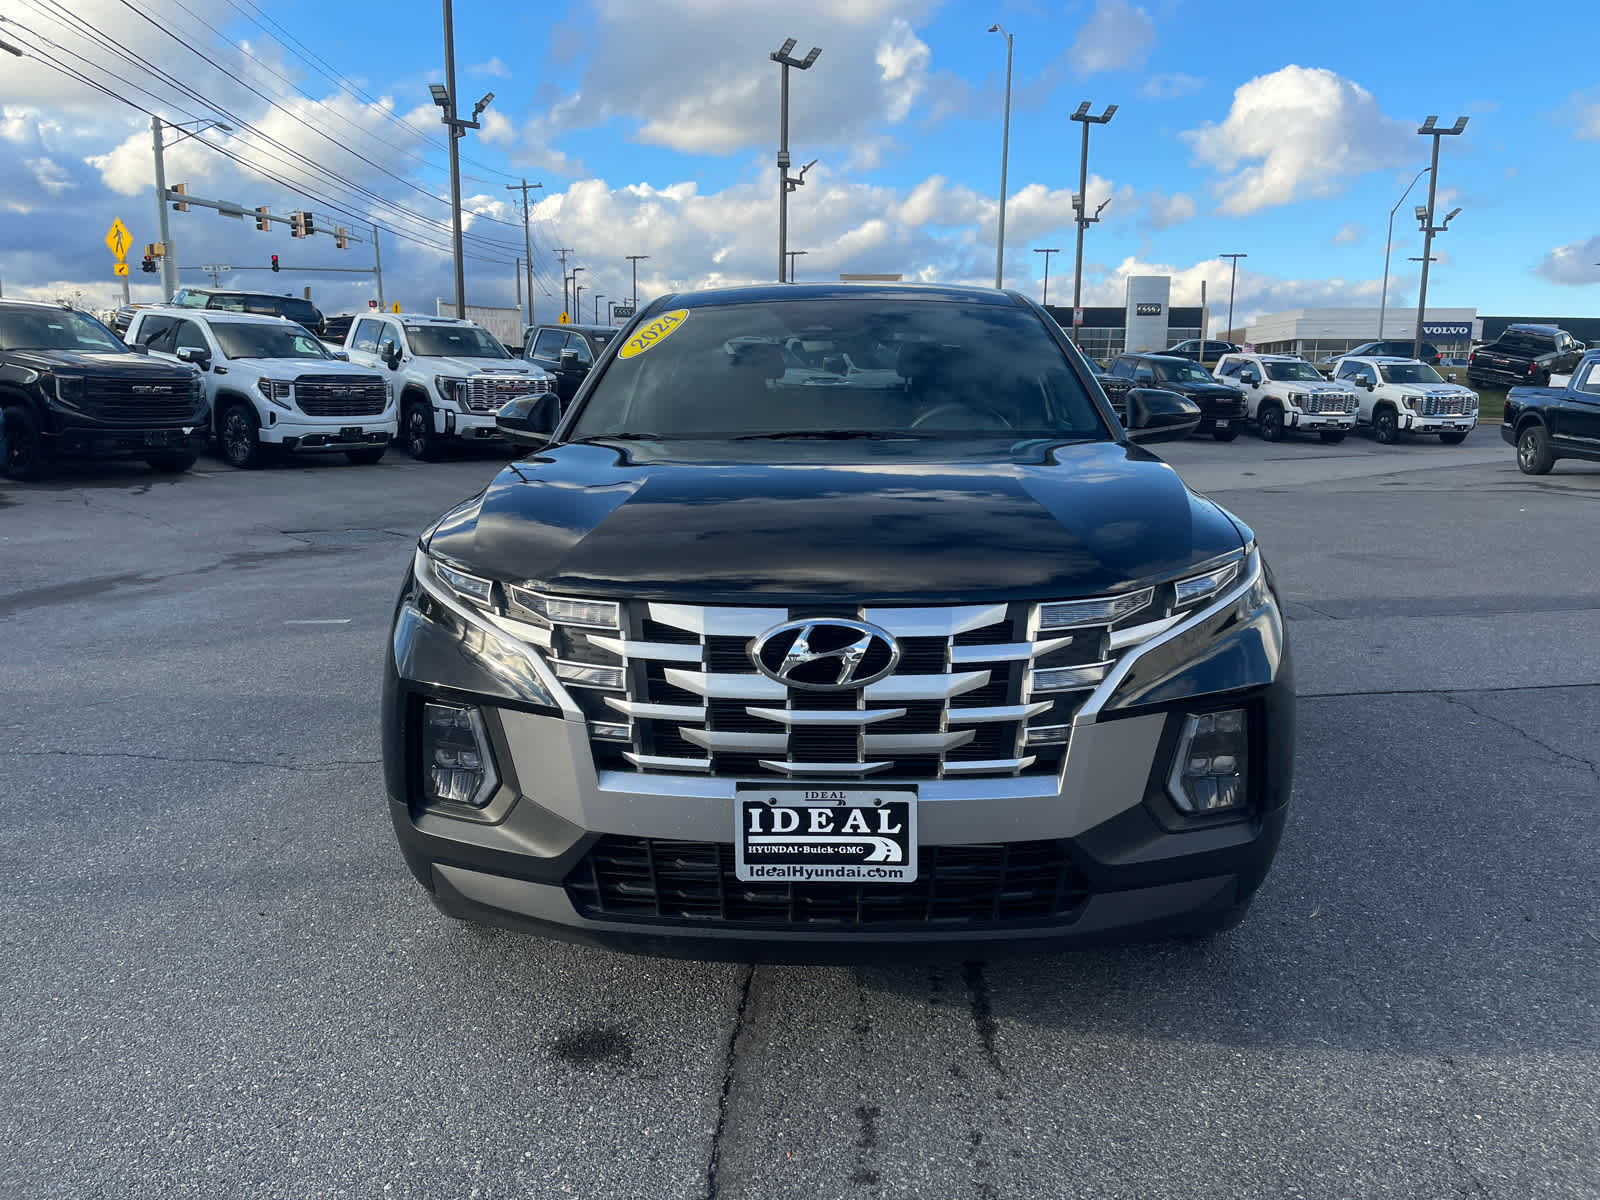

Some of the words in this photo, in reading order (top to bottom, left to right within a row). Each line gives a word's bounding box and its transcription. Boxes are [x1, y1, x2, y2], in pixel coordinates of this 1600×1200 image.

[630, 315, 680, 349] 2024
[1423, 326, 1468, 334] VOLVO
[805, 791, 846, 799] IDEAL
[748, 808, 902, 834] IDEAL
[749, 865, 904, 880] IdealHyundai.com
